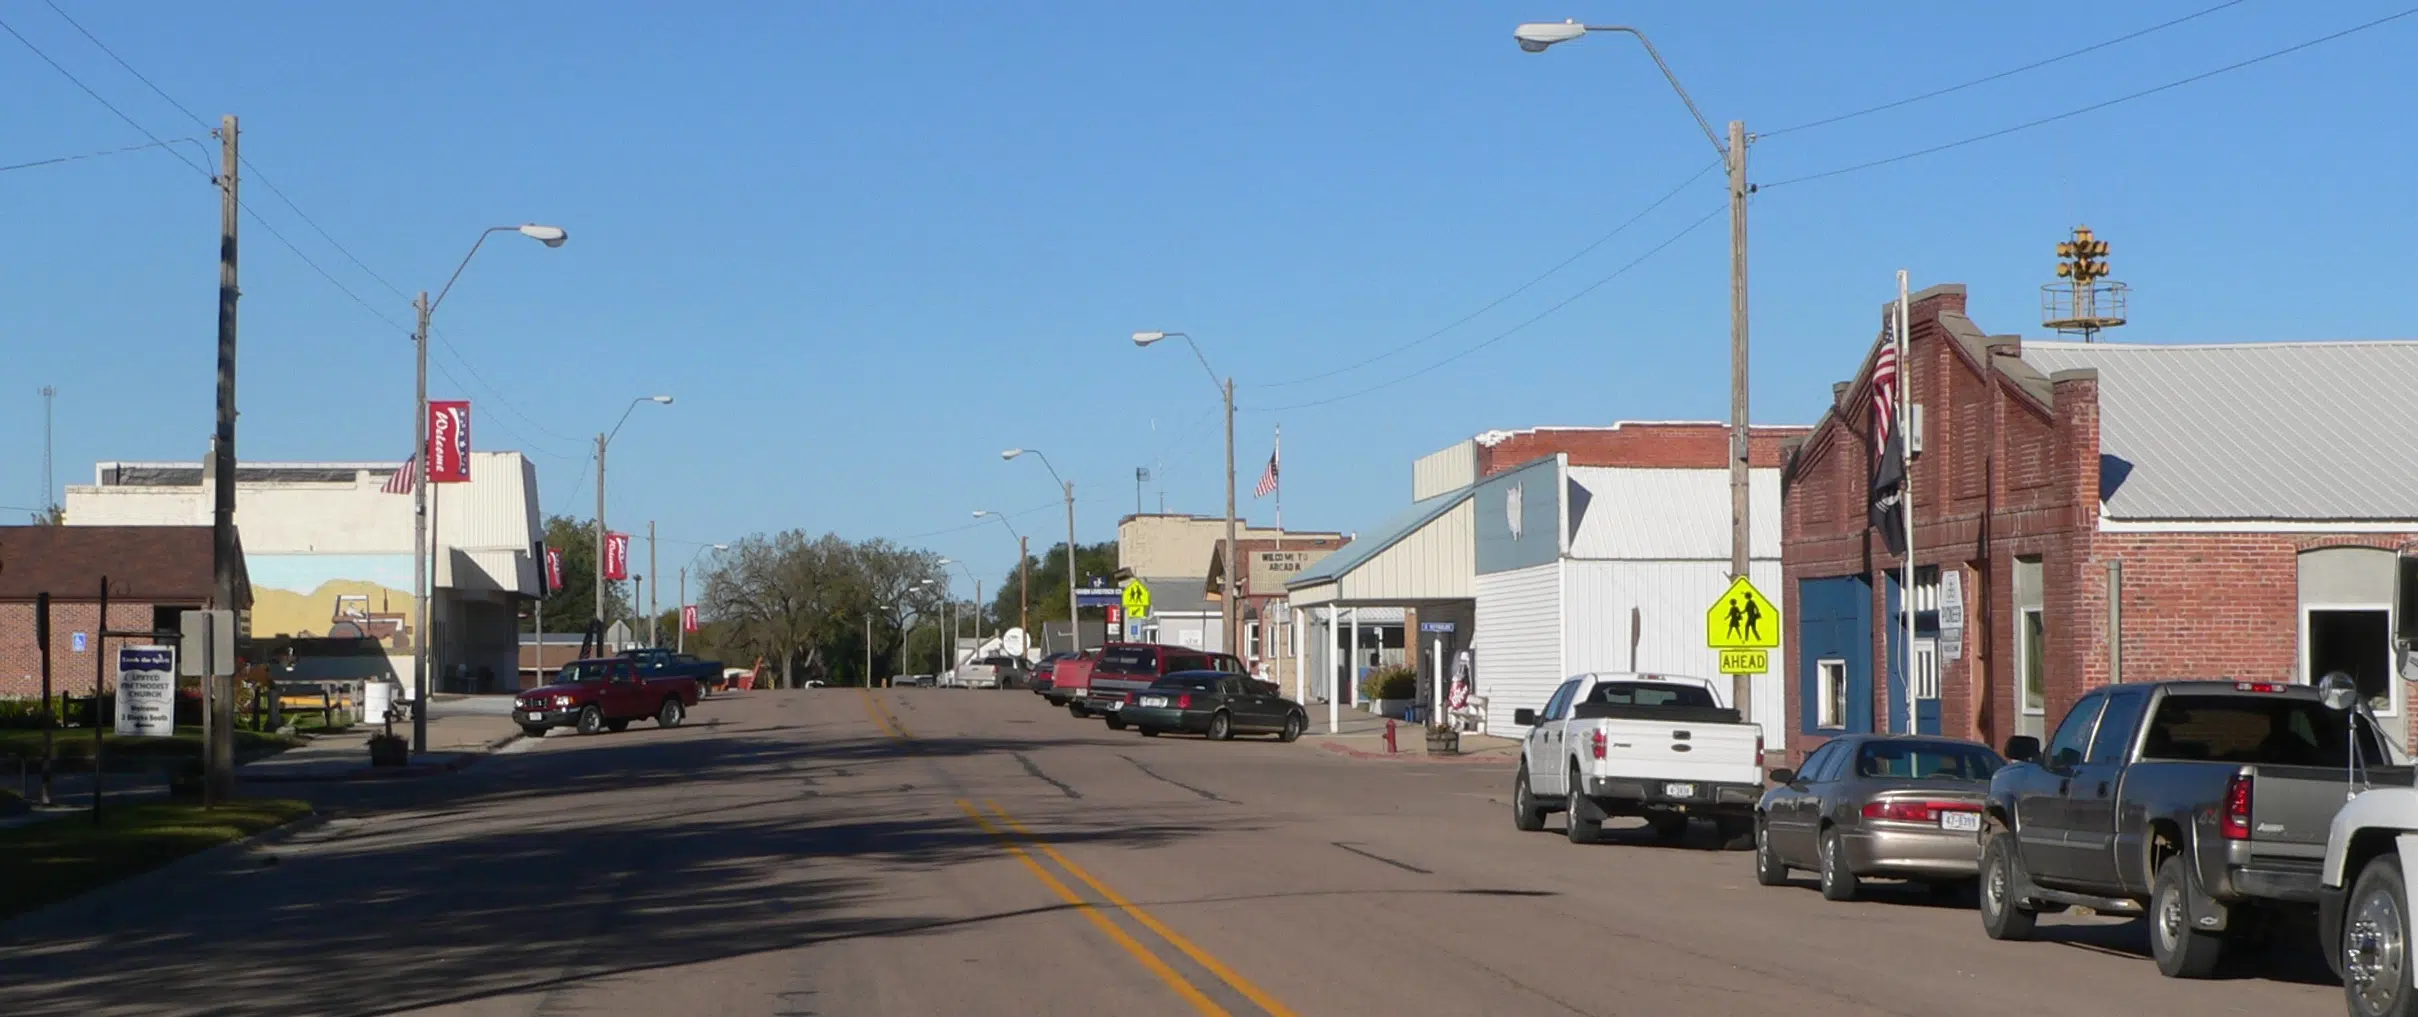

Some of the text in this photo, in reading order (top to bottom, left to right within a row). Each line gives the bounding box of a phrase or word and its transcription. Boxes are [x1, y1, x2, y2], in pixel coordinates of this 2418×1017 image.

[435, 410, 449, 473] Welcome
[1722, 654, 1765, 668] AHEAD
[121, 682, 169, 690] METHODIST
